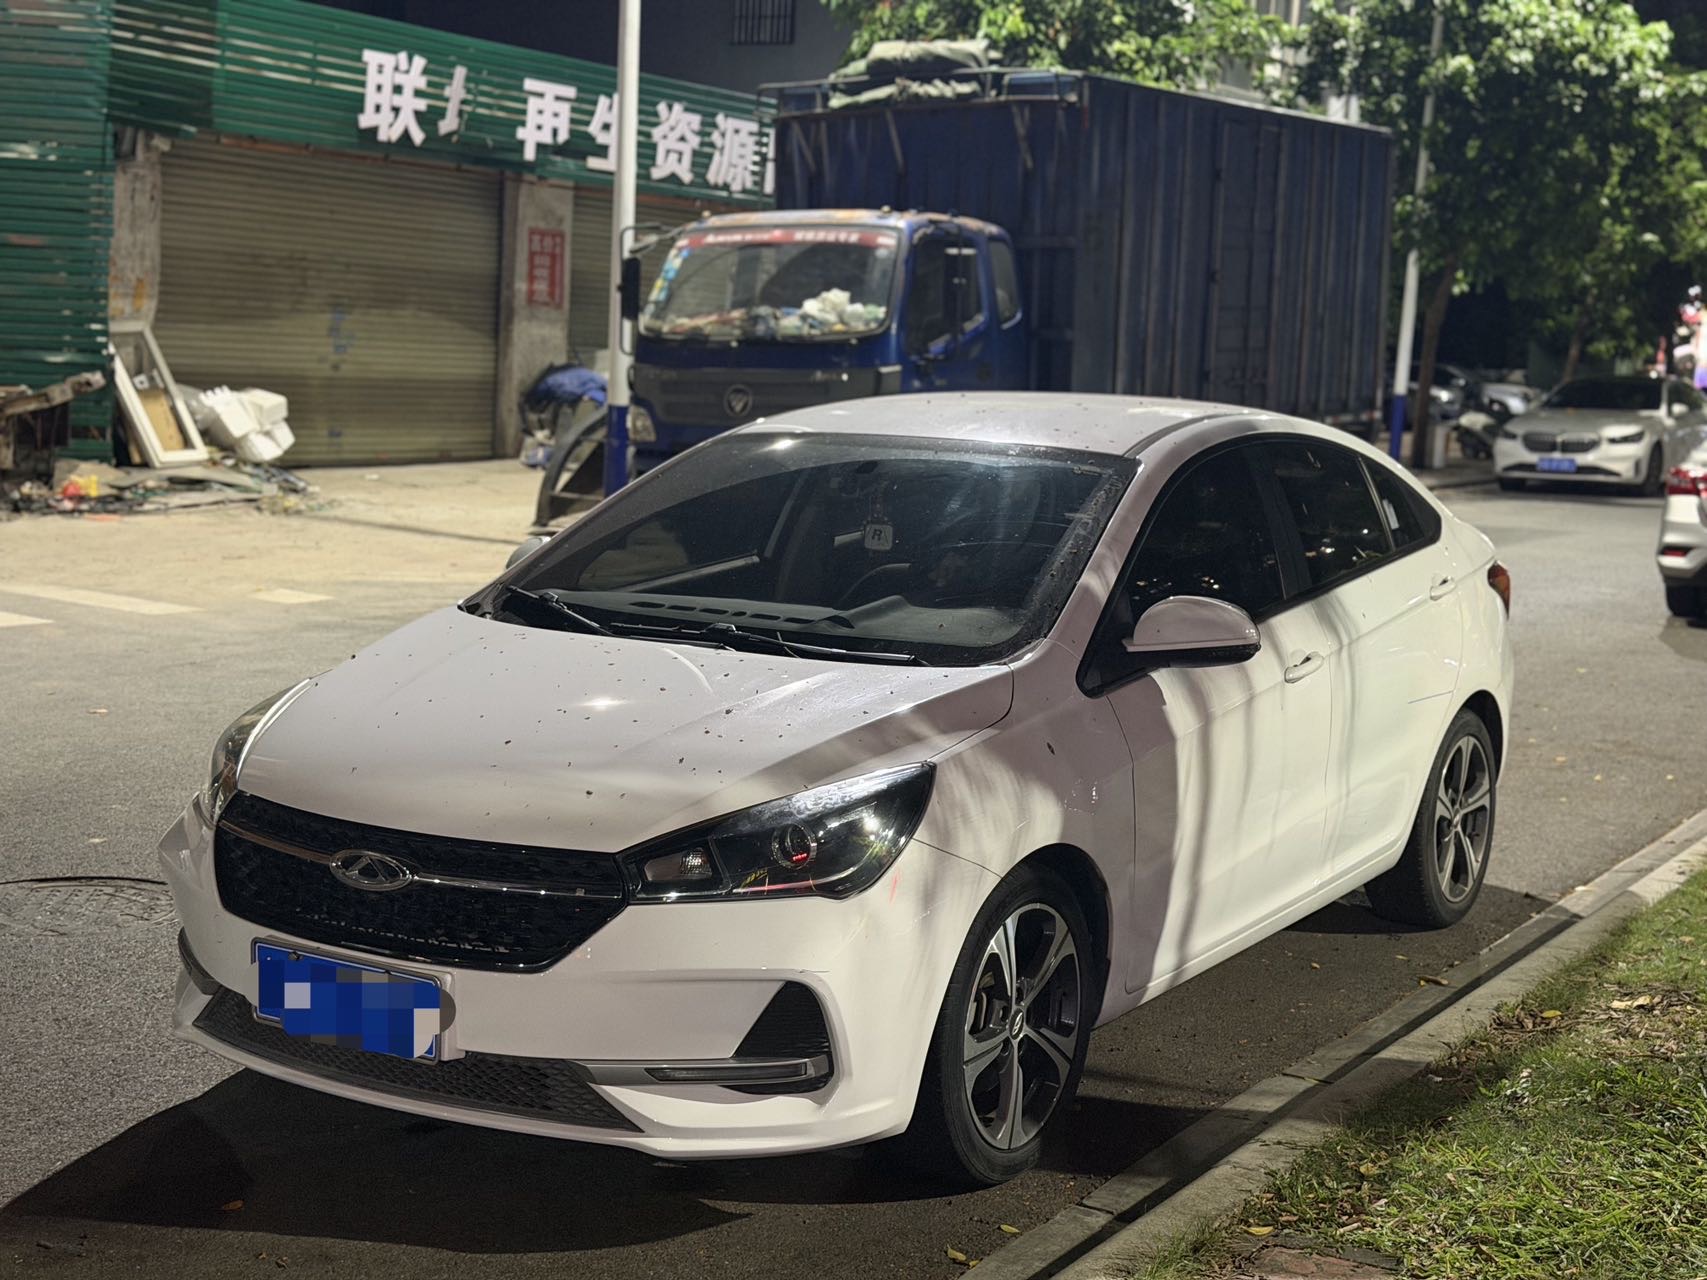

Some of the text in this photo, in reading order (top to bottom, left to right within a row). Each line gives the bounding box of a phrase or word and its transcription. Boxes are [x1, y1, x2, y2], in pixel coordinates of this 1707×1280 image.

[358, 49, 776, 195] 联再生资源
[871, 528, 883, 541] R
